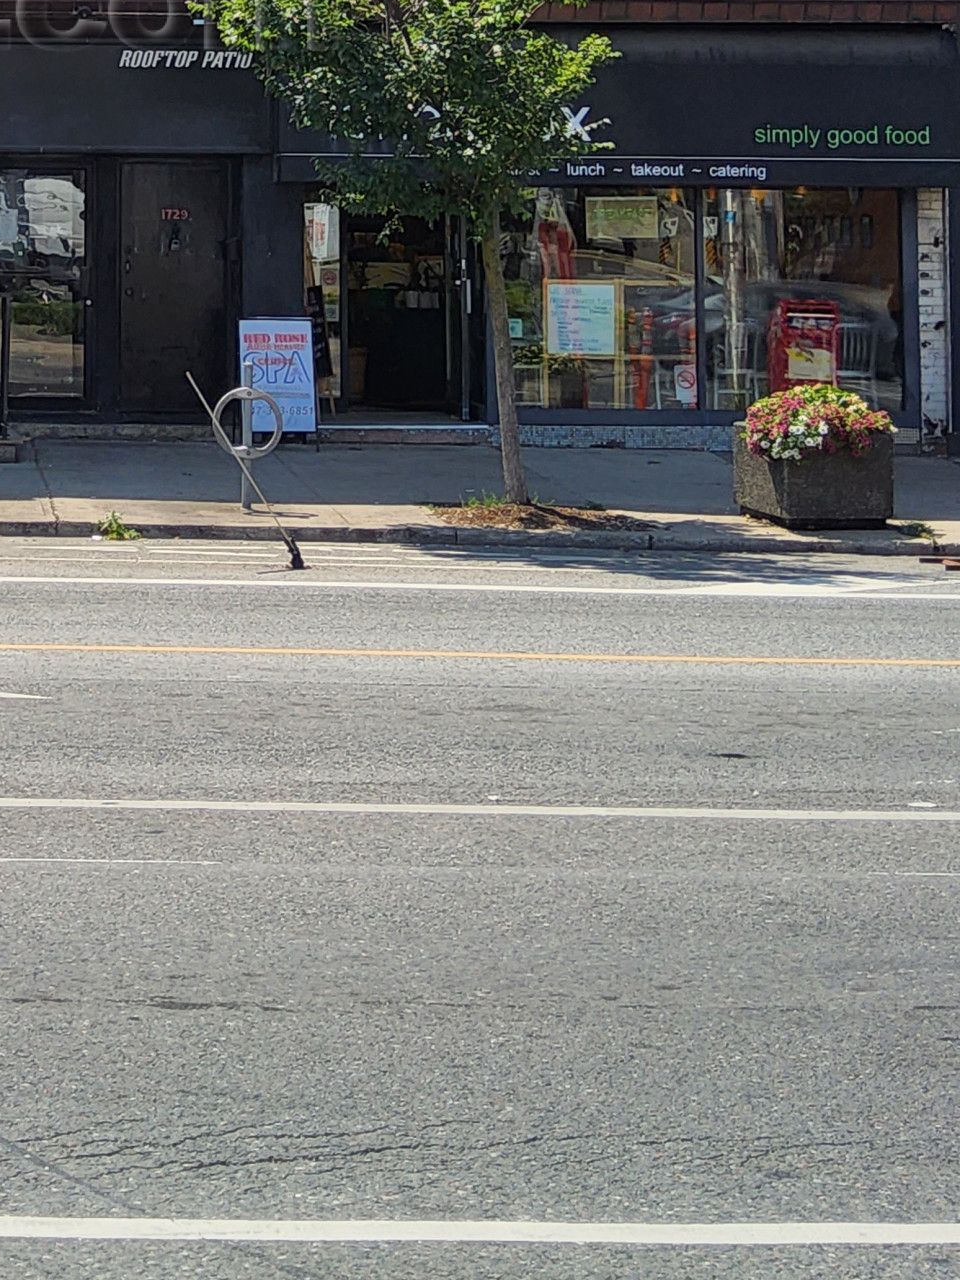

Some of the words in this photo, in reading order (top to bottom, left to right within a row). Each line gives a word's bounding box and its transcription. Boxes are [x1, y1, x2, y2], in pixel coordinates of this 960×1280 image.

[119, 50, 199, 69] ROOFTOP
[754, 124, 821, 148] simply
[827, 125, 878, 149] good
[885, 125, 930, 145] food
[566, 162, 605, 176] lunch
[631, 163, 684, 177] takeout
[709, 163, 767, 181] catering
[161, 208, 189, 220] 1729
[243, 333, 271, 344] RED
[274, 333, 309, 344] ROSE
[242, 350, 311, 384] SPA
